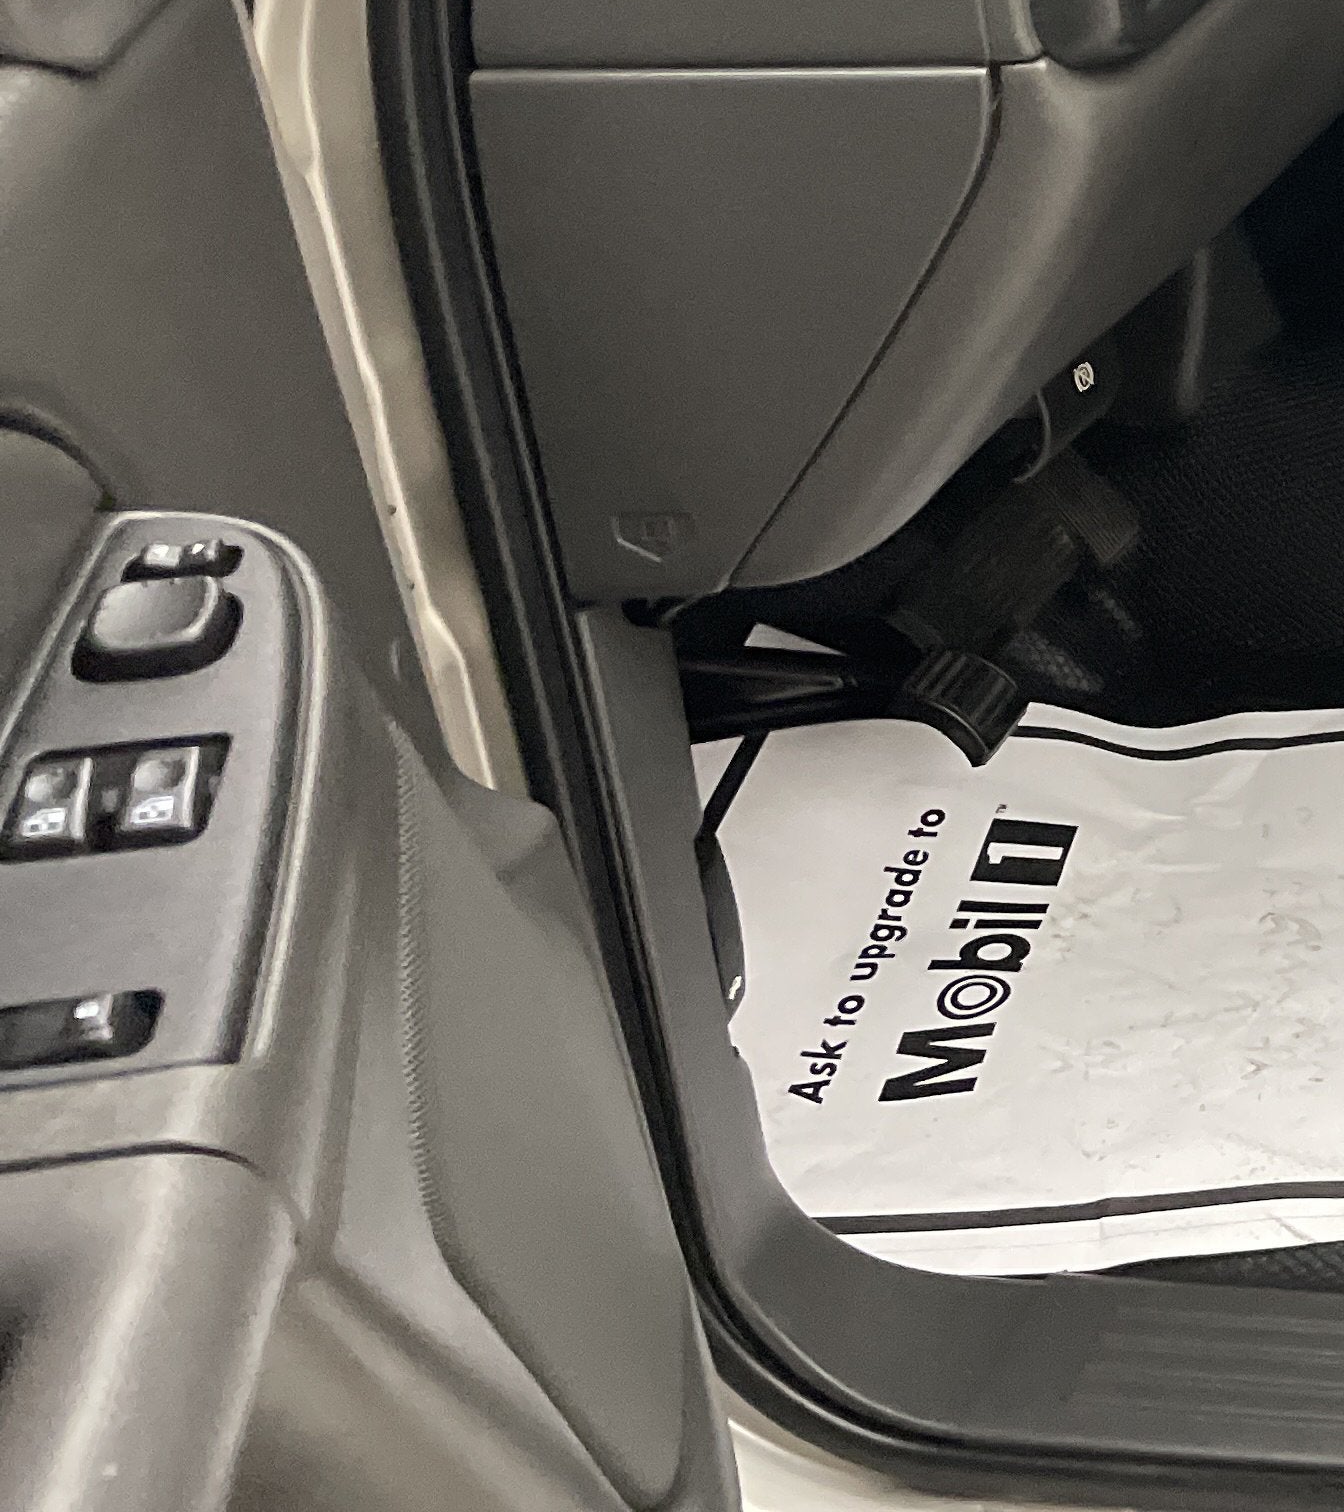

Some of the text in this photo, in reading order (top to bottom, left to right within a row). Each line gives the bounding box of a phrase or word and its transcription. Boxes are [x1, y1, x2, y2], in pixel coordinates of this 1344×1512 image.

[787, 808, 946, 1105] Ask to upgrade to
[877, 899, 1050, 1103] Mobil
